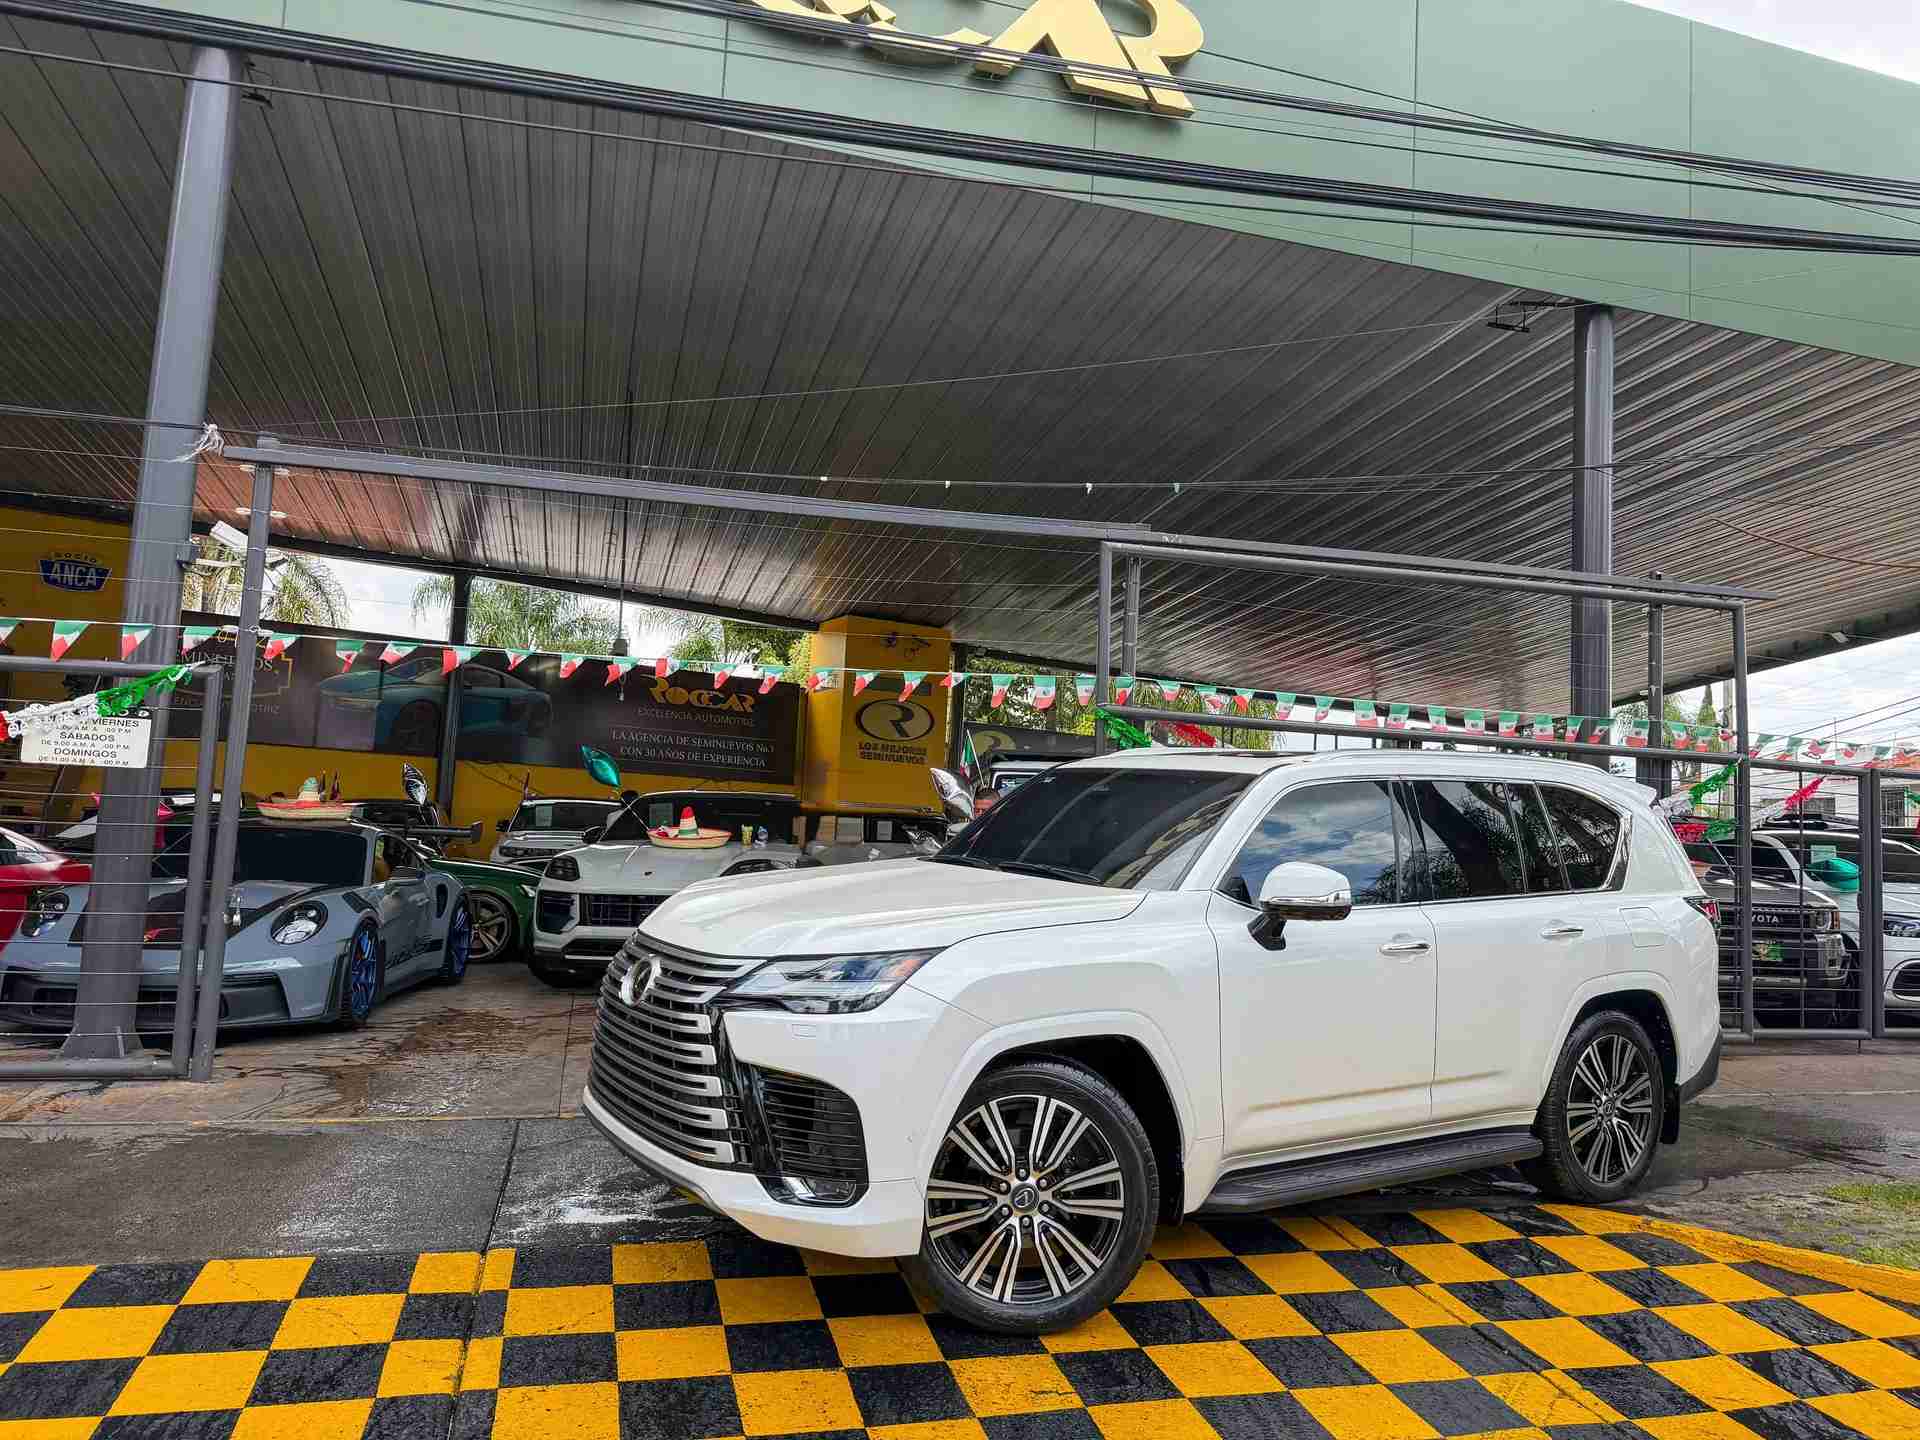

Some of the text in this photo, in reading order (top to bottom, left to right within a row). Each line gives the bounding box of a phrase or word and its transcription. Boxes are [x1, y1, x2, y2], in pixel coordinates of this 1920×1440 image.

[50, 562, 97, 587] ANCA
[92, 718, 140, 728] VIERNES
[612, 728, 628, 740] LA
[628, 730, 675, 745] AGENCIA
[676, 735, 690, 745] DE
[691, 737, 754, 752] SEMINUEVOS
[54, 748, 118, 759] DOMINGOS
[620, 746, 643, 757] CON
[687, 752, 702, 761] DE
[703, 753, 767, 768] EXPERIENCIA
